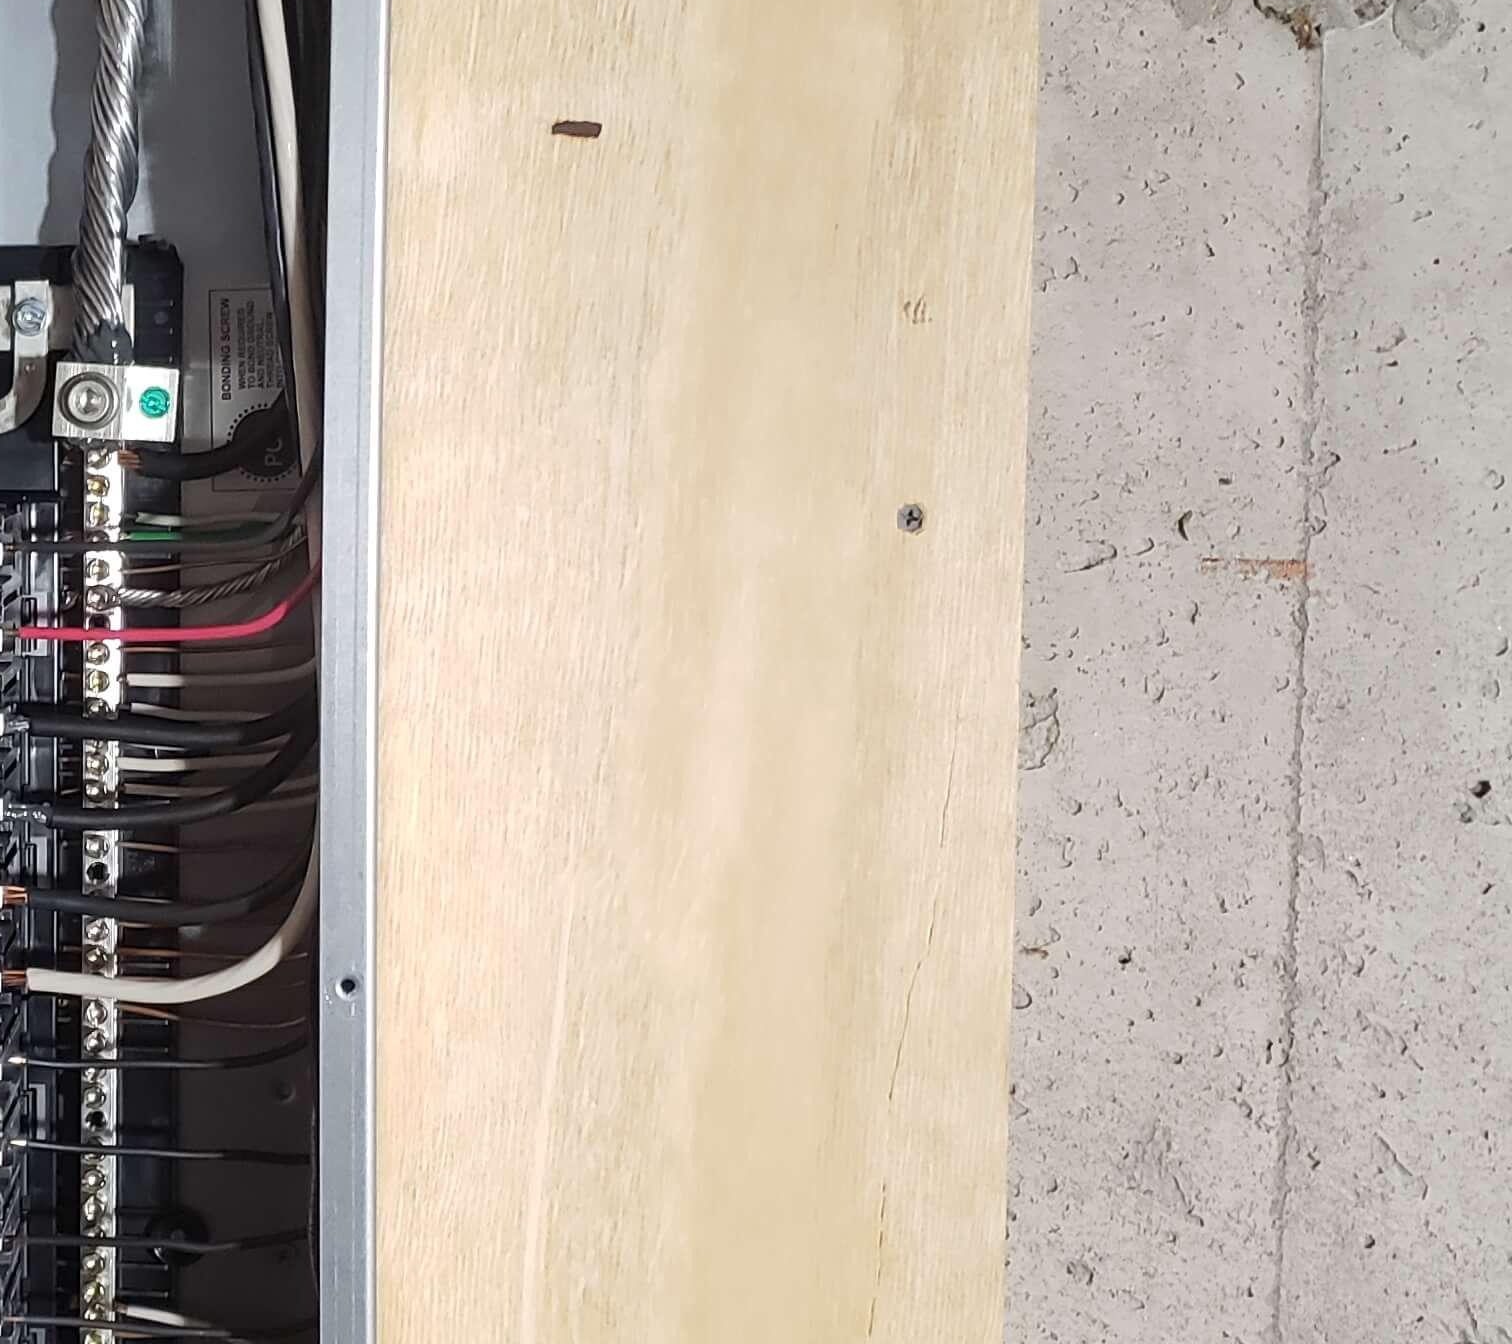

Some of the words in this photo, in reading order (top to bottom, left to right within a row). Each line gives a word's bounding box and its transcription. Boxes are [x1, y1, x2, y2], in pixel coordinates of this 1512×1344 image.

[221, 298, 230, 341] SCREW
[237, 308, 246, 358] REQUIRED
[221, 345, 232, 400] BONDING
[247, 345, 255, 373] BOND
[237, 360, 246, 390] WHEN
[247, 376, 255, 390] TO
[257, 368, 265, 390] AND
